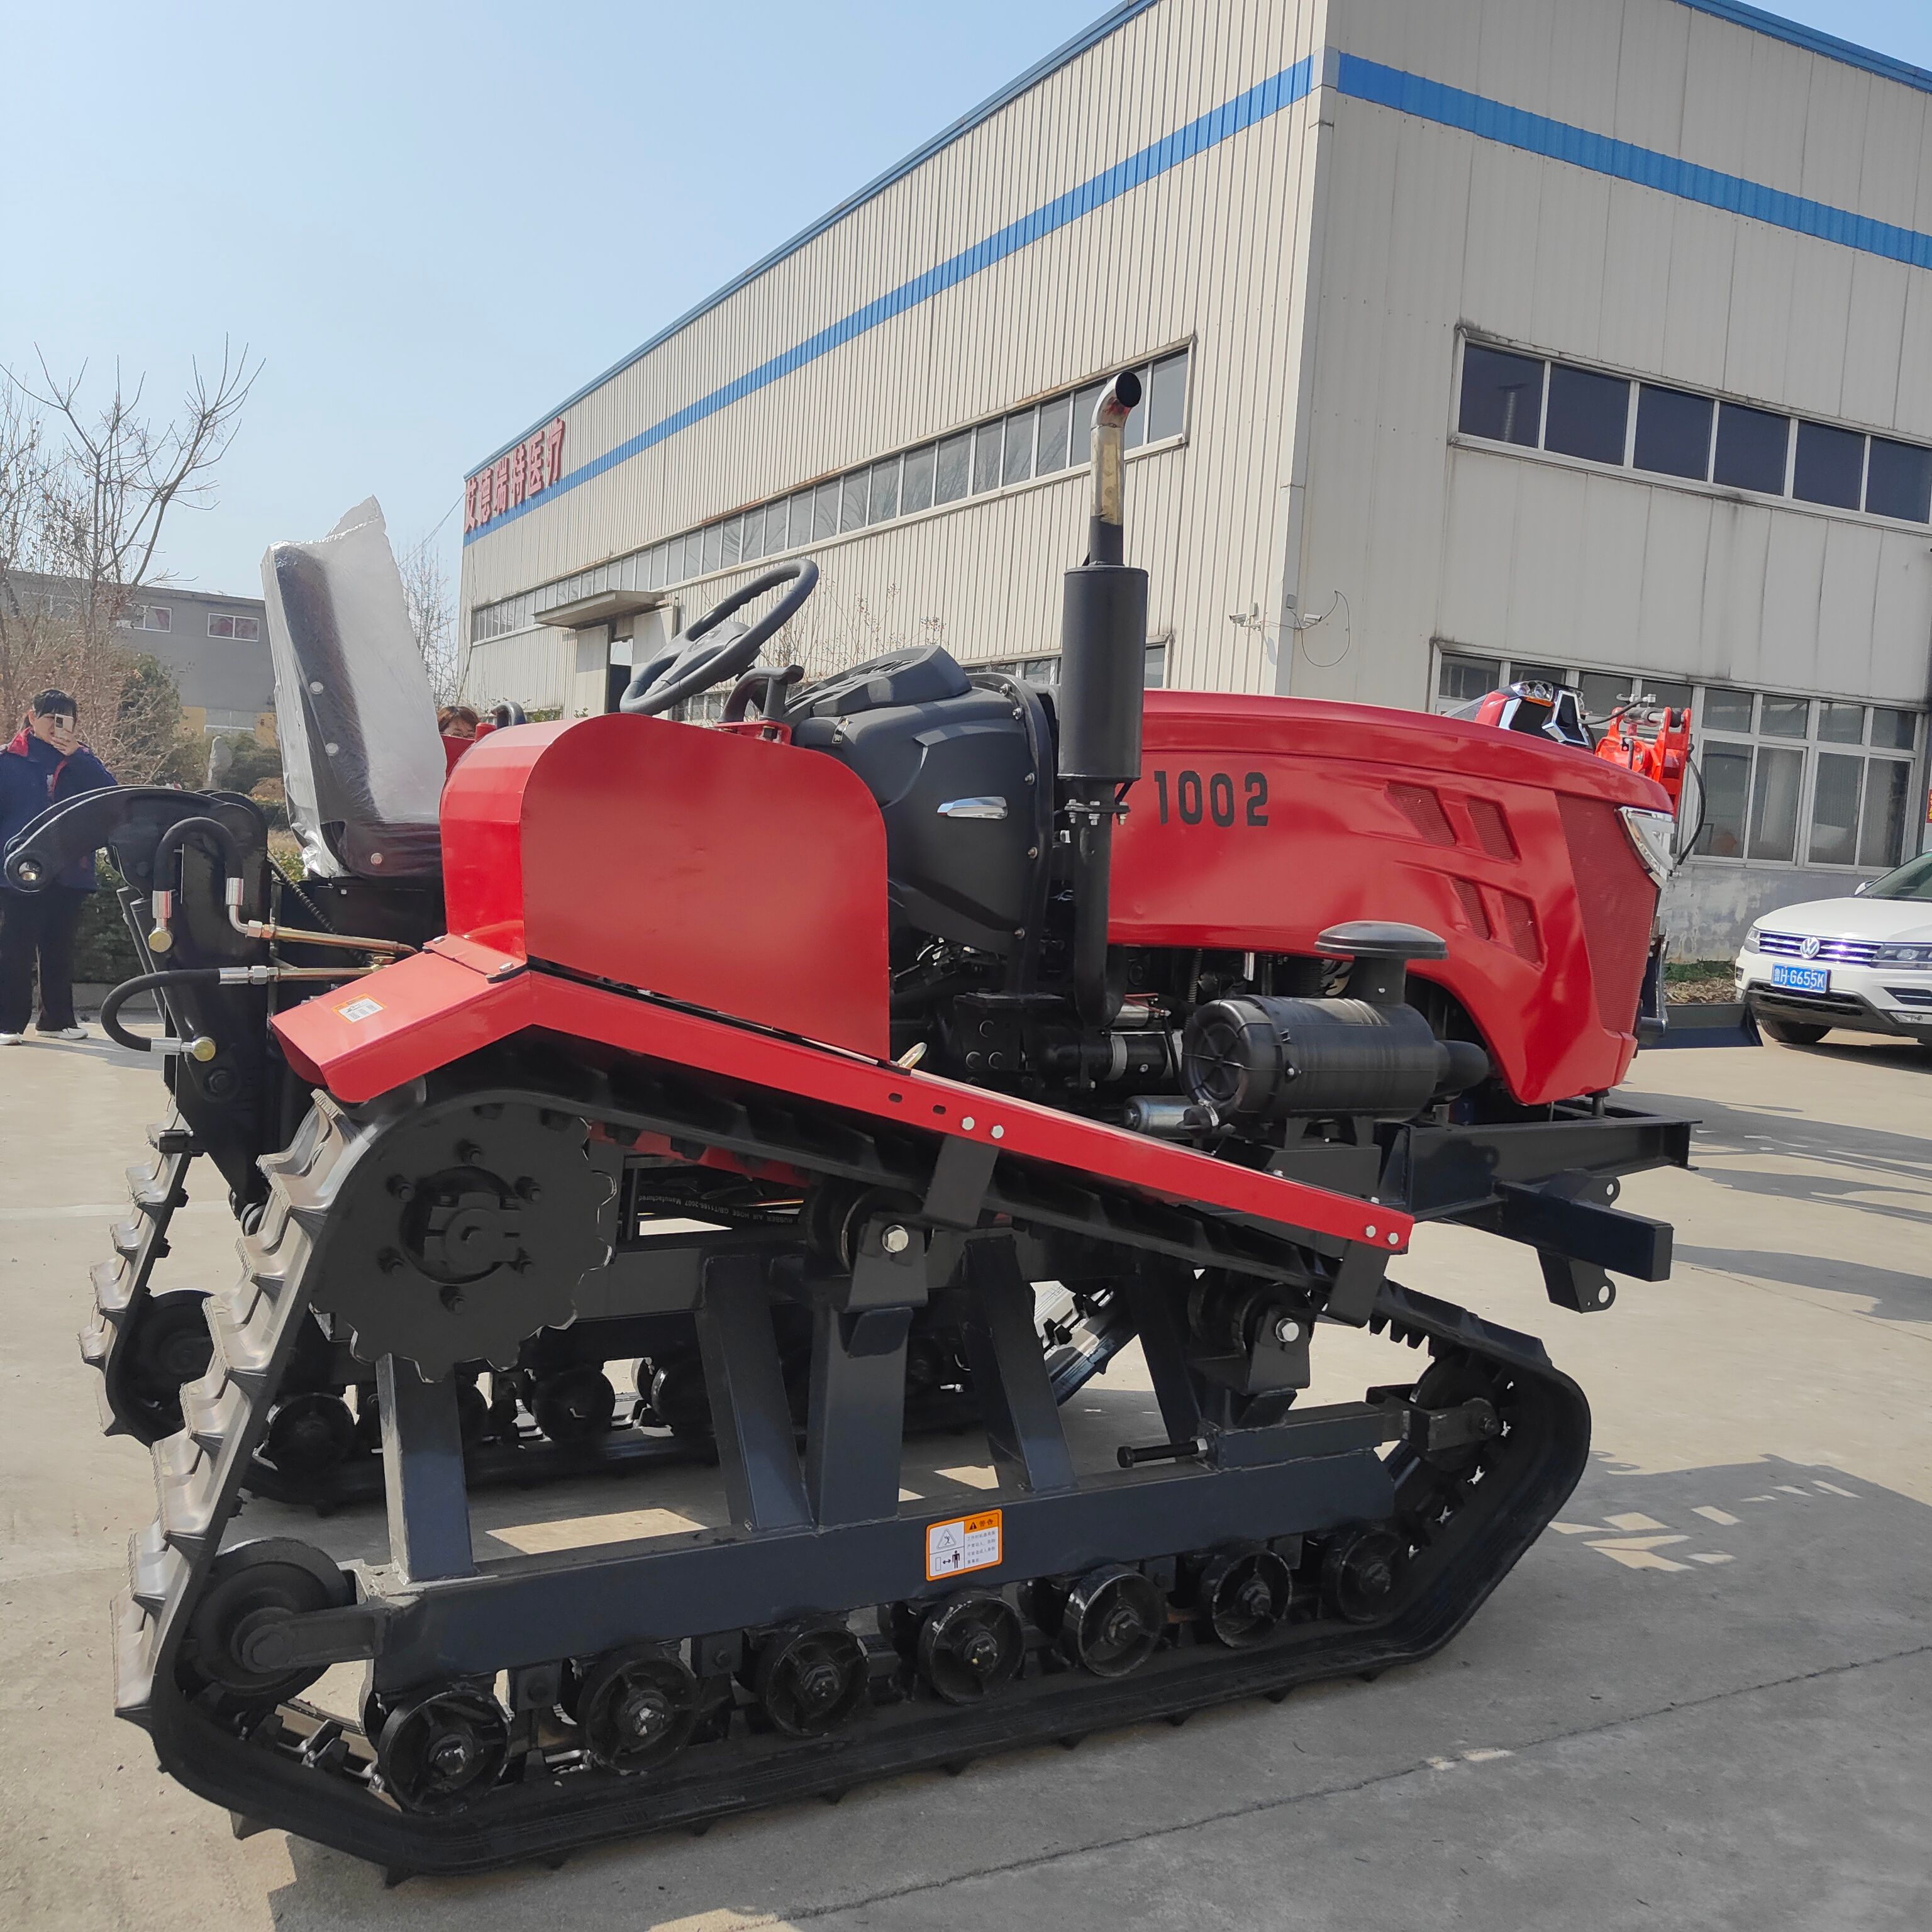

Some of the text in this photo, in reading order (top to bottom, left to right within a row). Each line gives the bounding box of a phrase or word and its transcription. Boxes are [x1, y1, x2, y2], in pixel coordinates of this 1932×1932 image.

[1154, 770, 1269, 828] 1002
[638, 1195, 682, 1205] Manufactured
[732, 1209, 749, 1219] HOSE
[767, 1215, 793, 1224] RUBBER
